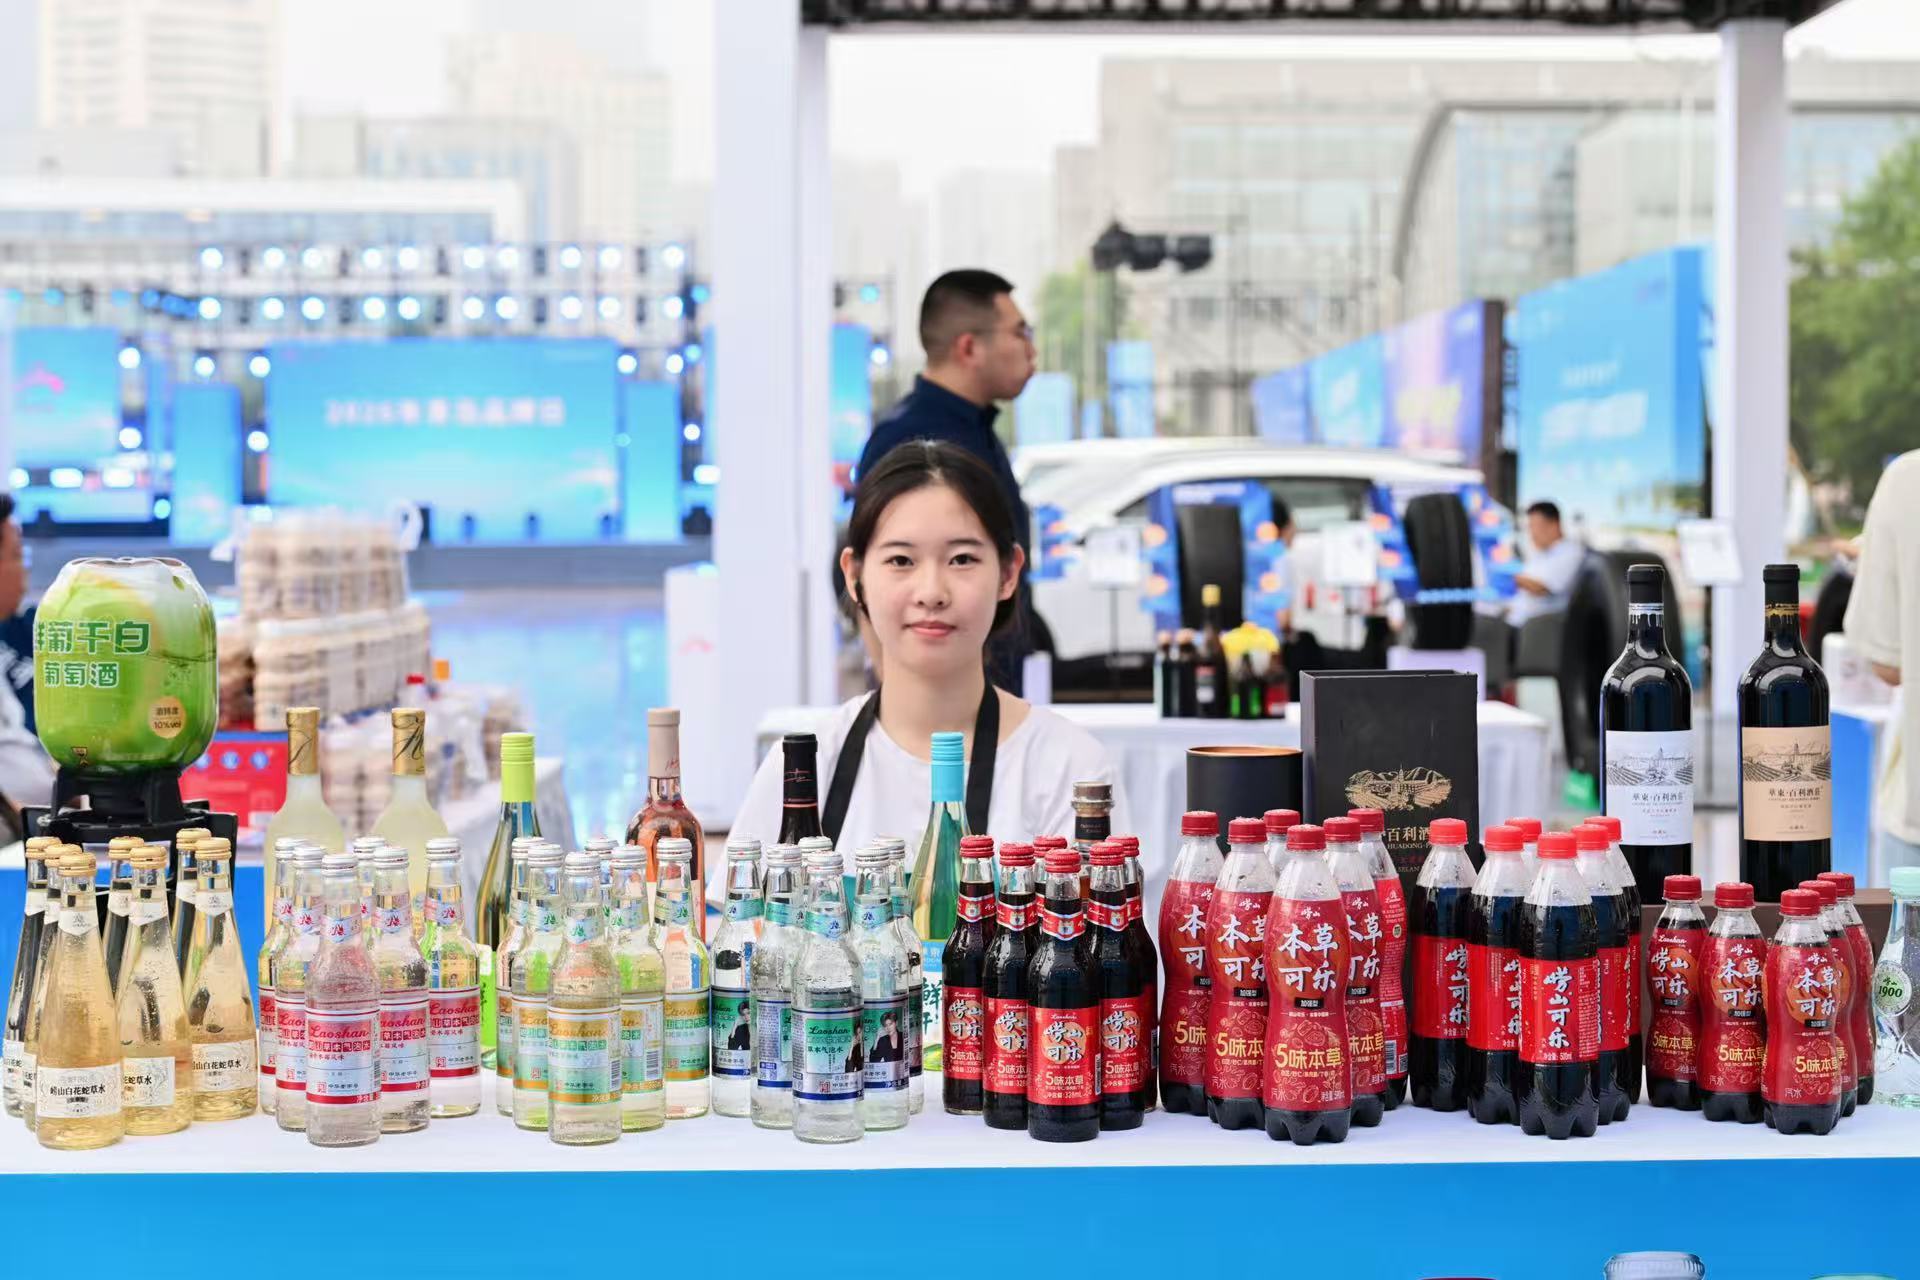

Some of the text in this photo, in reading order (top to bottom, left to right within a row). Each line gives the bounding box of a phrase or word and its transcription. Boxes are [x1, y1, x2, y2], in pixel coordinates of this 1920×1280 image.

[45, 662, 118, 687] 葡萄酒
[1239, 898, 1261, 911] 崂山
[1351, 896, 1369, 910] 崂山
[1301, 906, 1321, 920] 崂山
[1278, 922, 1338, 960] 本草
[1658, 934, 1687, 944] Laoshan
[1651, 947, 1689, 972] 崂山
[1730, 943, 1753, 957] 崂山
[1808, 952, 1828, 966] 崂山
[1278, 961, 1337, 993] 可乐
[1718, 957, 1762, 984] 本草
[1794, 966, 1837, 993] 本草
[1445, 943, 1468, 1025] 崂山可乐
[1652, 972, 1690, 995] 可乐
[1883, 976, 1898, 986] 崂山
[1718, 984, 1762, 1008] 可乐
[1879, 985, 1903, 998] 1900
[949, 998, 982, 1019] 崂山
[1300, 999, 1319, 1007] 加强型
[1543, 966, 1573, 1049] 崂山可乐
[1796, 993, 1836, 1017] 可乐
[808, 1025, 849, 1036] Laoshan
[950, 1019, 982, 1038] 可乐
[1102, 1010, 1138, 1032] 崂山
[310, 1025, 370, 1039] Laoshan
[1043, 1020, 1083, 1042] 崂山
[1103, 1029, 1138, 1050] 可乐
[1174, 1020, 1206, 1045] 5味
[1653, 1031, 1693, 1050] 5味本草
[1046, 1041, 1084, 1061] 可乐
[1275, 1043, 1342, 1070] 5味本草
[1105, 1060, 1140, 1075] 5味本草
[1045, 1071, 1084, 1086] 5味本草
[1709, 1075, 1725, 1086] 汽水
[50, 1083, 106, 1096] 崂山白花蛇草水
[1271, 1087, 1286, 1101] 汽水
[1785, 1087, 1802, 1098] 汽水
